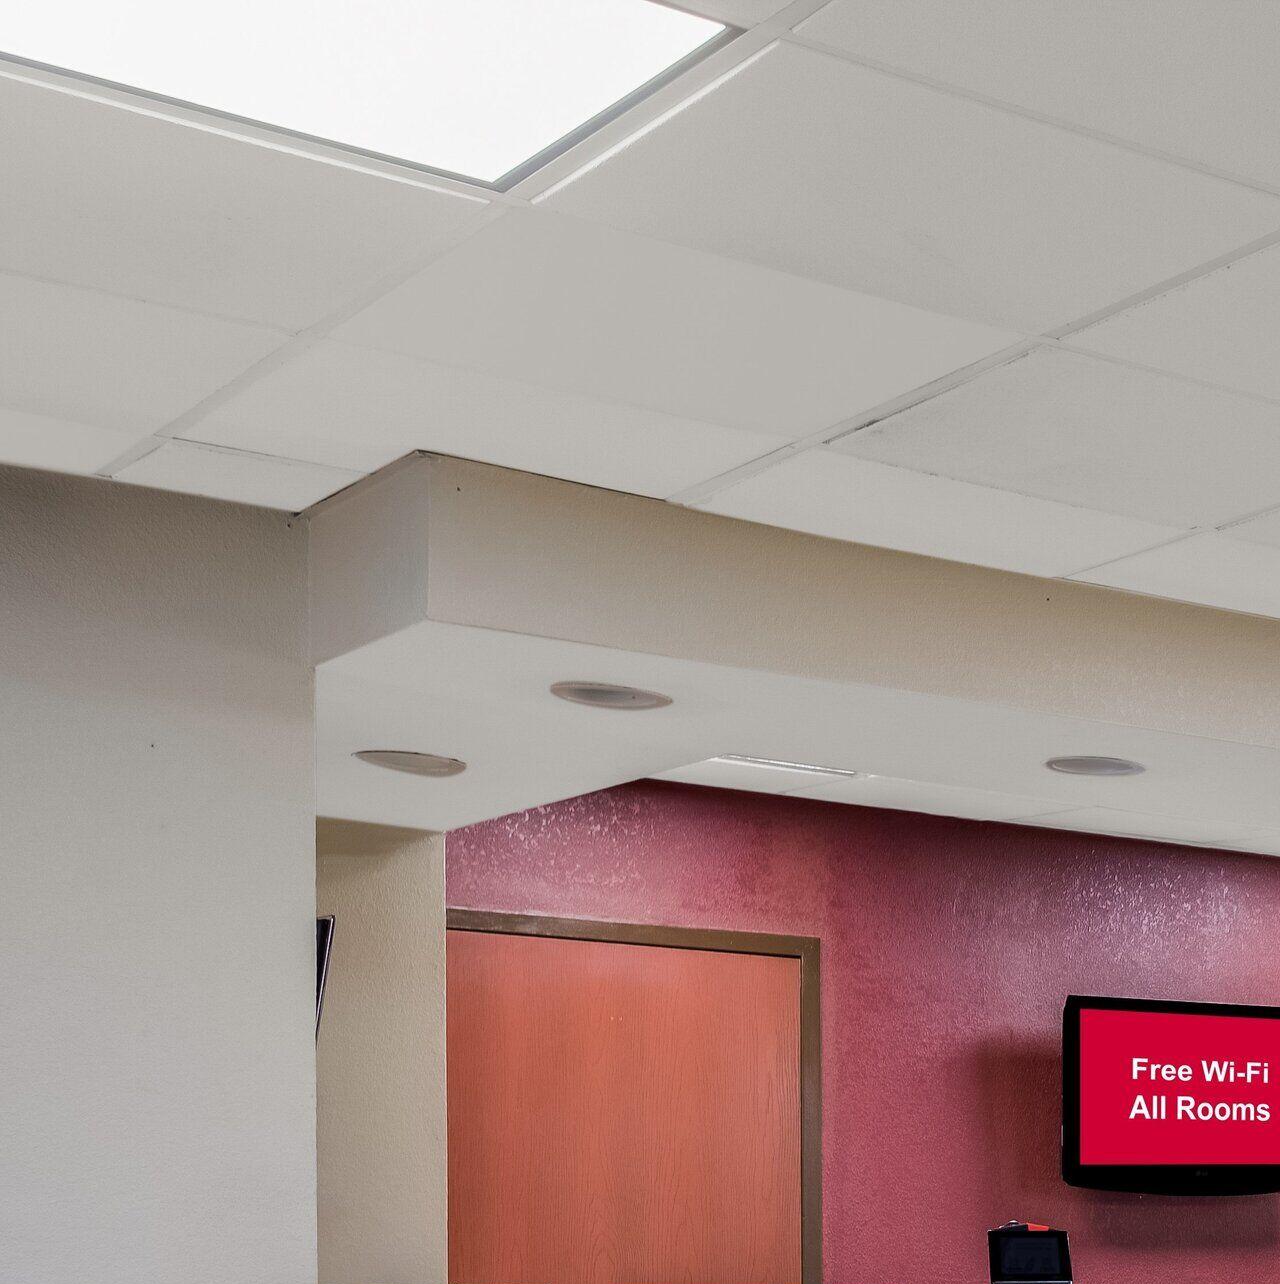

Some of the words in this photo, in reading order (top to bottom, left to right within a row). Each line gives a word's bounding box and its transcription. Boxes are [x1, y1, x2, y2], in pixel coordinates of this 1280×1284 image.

[1132, 1058, 1193, 1081] Free
[1201, 1061, 1269, 1083] Wi-Fi
[1129, 1095, 1166, 1119] All
[1176, 1096, 1271, 1122] Rooms
